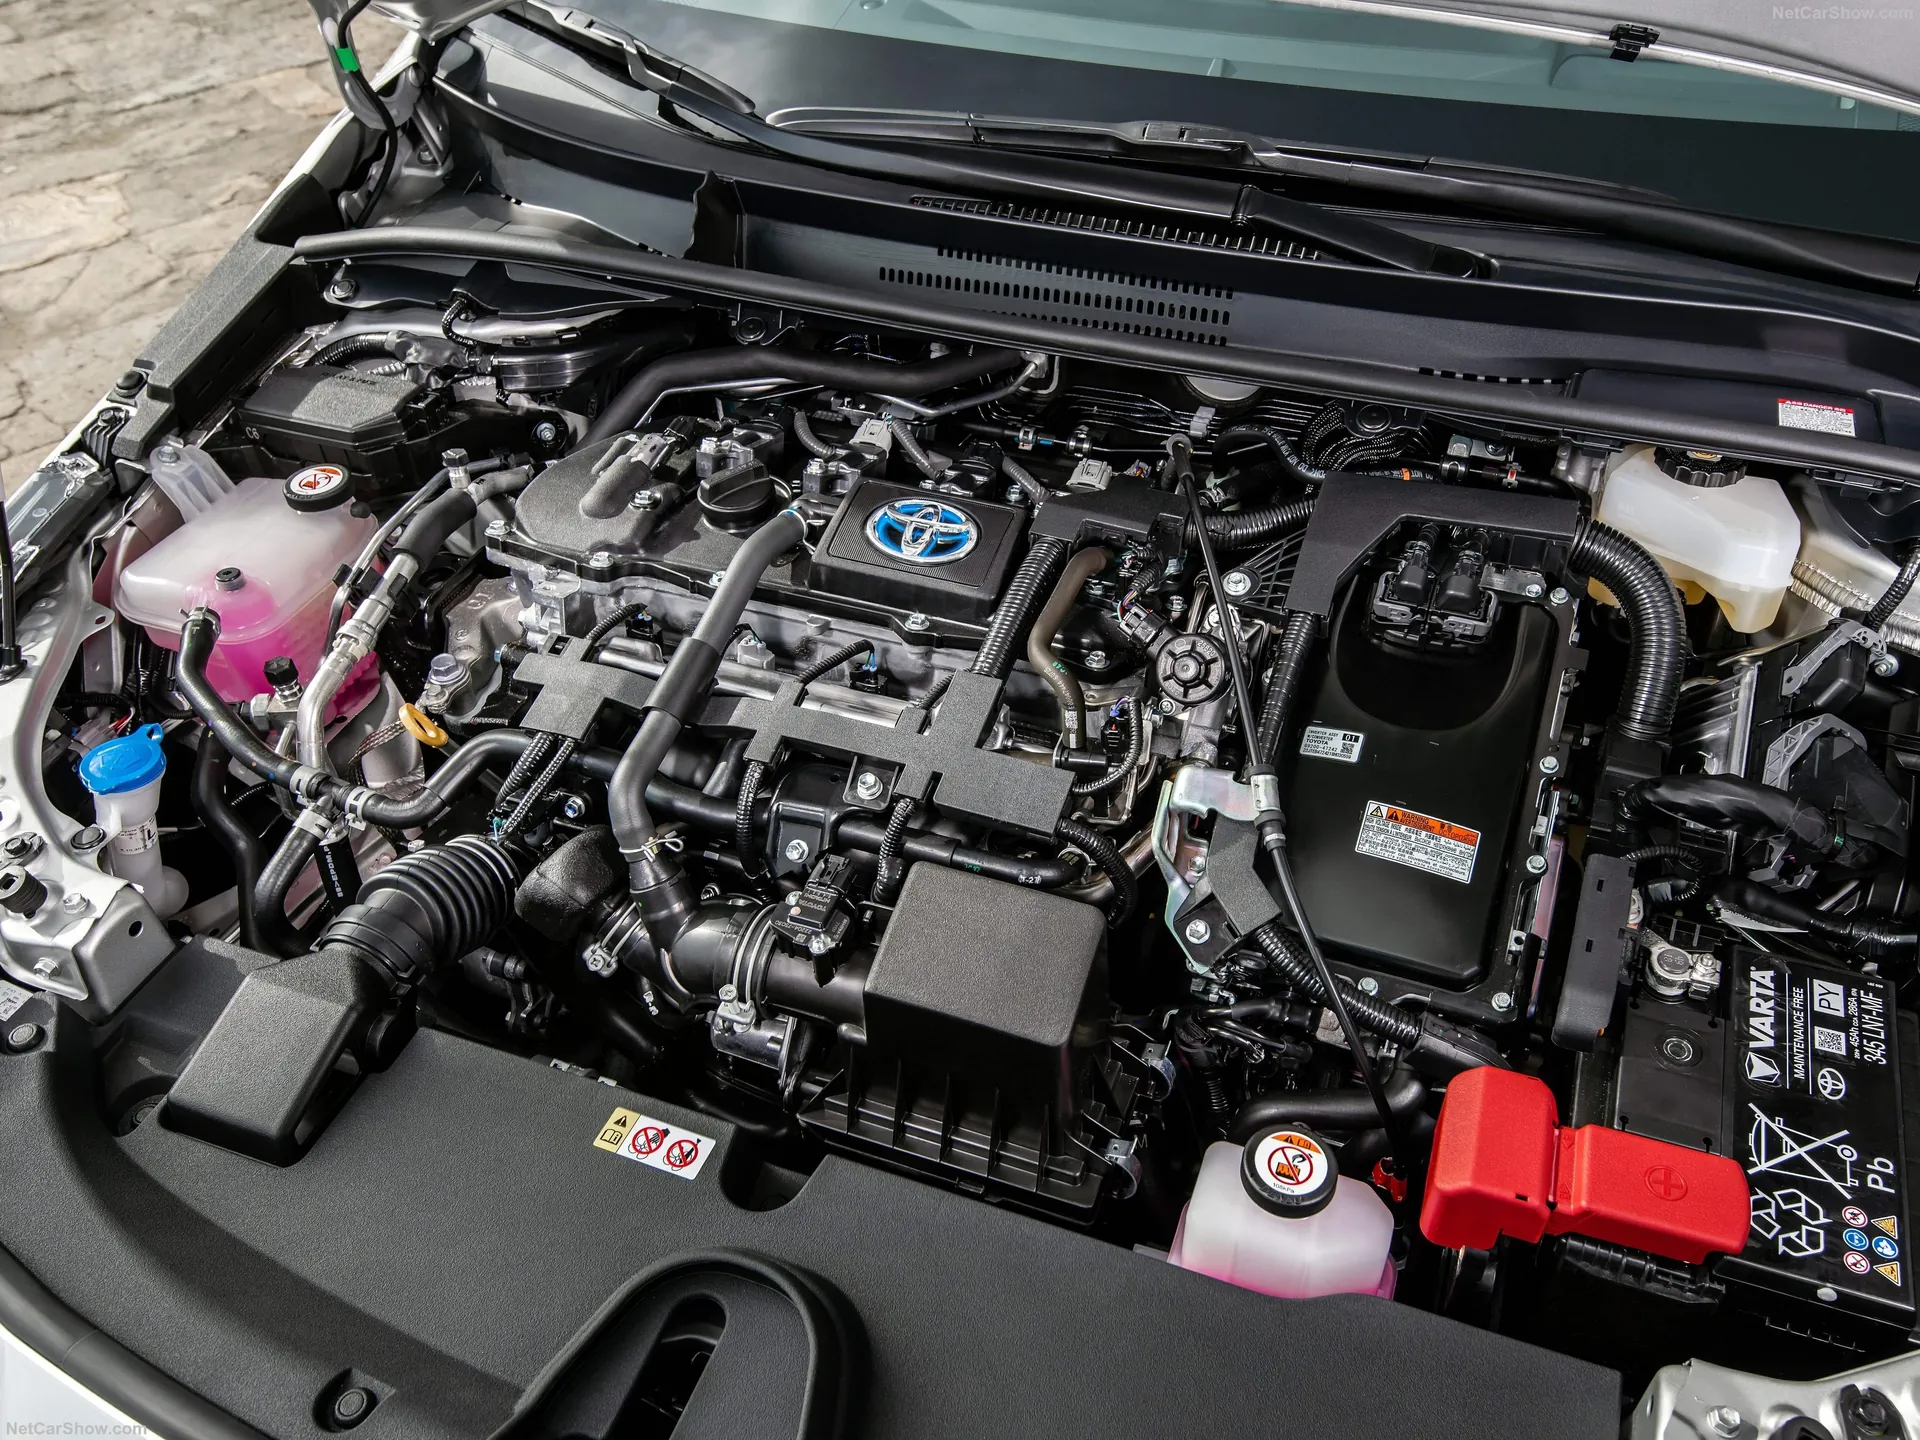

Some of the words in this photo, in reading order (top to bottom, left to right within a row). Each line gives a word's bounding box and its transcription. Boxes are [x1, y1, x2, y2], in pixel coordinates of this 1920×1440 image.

[1197, 640, 1215, 657] 25620
[1401, 812, 1430, 825] WARNING
[798, 899, 826, 911] TOYOTA
[804, 893, 831, 903] HITACHI
[1750, 971, 1776, 1048] VARTA
[1792, 988, 1804, 1010] FREE
[1819, 984, 1840, 1012] PY
[1860, 990, 1885, 1038] LN1-MF
[1793, 1012, 1805, 1080] MAINTENANCE
[1849, 1025, 1860, 1047] 45Ah
[1864, 1040, 1886, 1064] 345
[1867, 1157, 1896, 1194] Pb
